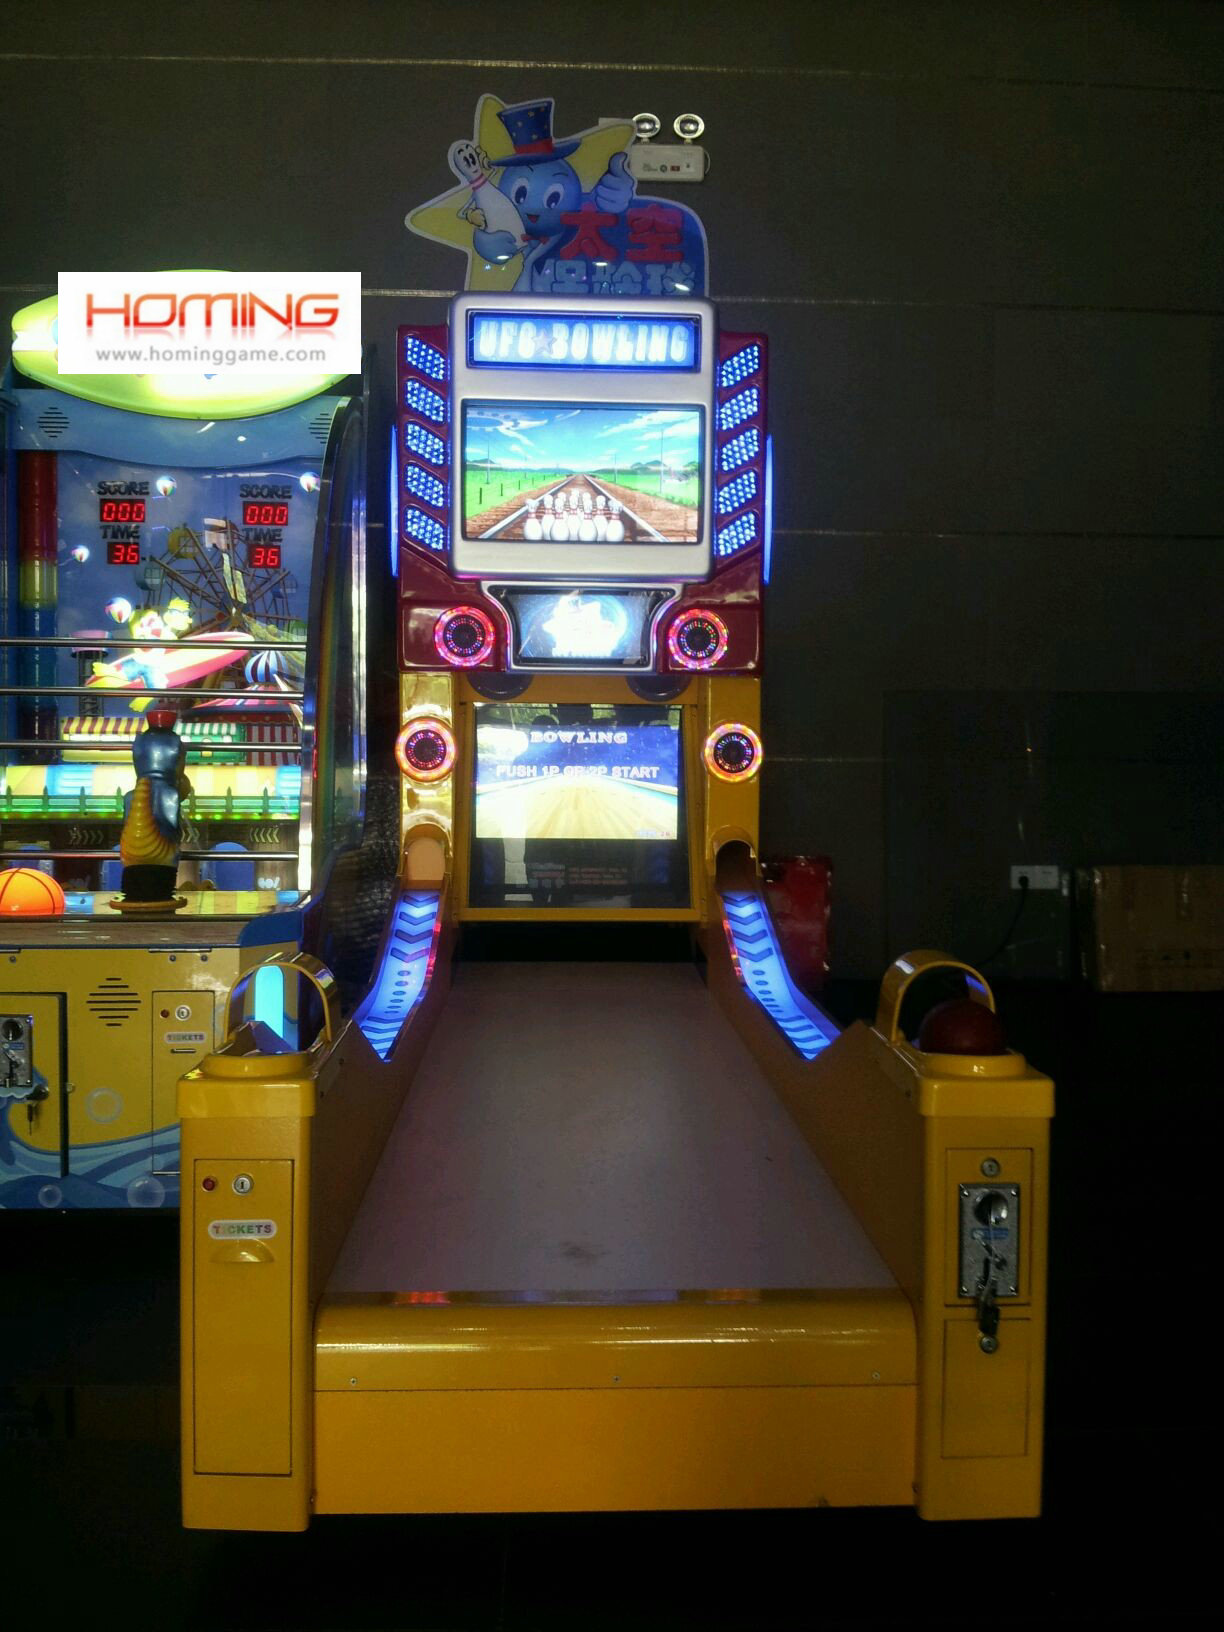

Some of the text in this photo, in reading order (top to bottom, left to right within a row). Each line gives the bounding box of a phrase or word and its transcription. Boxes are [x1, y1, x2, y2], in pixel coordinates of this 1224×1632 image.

[559, 202, 684, 262] 太空
[479, 320, 689, 363] UFO BOWLING
[97, 481, 149, 496] SCORE
[240, 483, 292, 499] SCORE
[103, 502, 145, 522] 000
[245, 505, 288, 524] 000
[100, 524, 140, 540] TIME
[243, 528, 283, 544] TIME
[113, 544, 139, 564] 36
[253, 548, 279, 566] 36
[530, 730, 628, 744] BOWLING
[496, 765, 537, 777] PUSH
[542, 765, 560, 777] 1P
[611, 766, 659, 779] START
